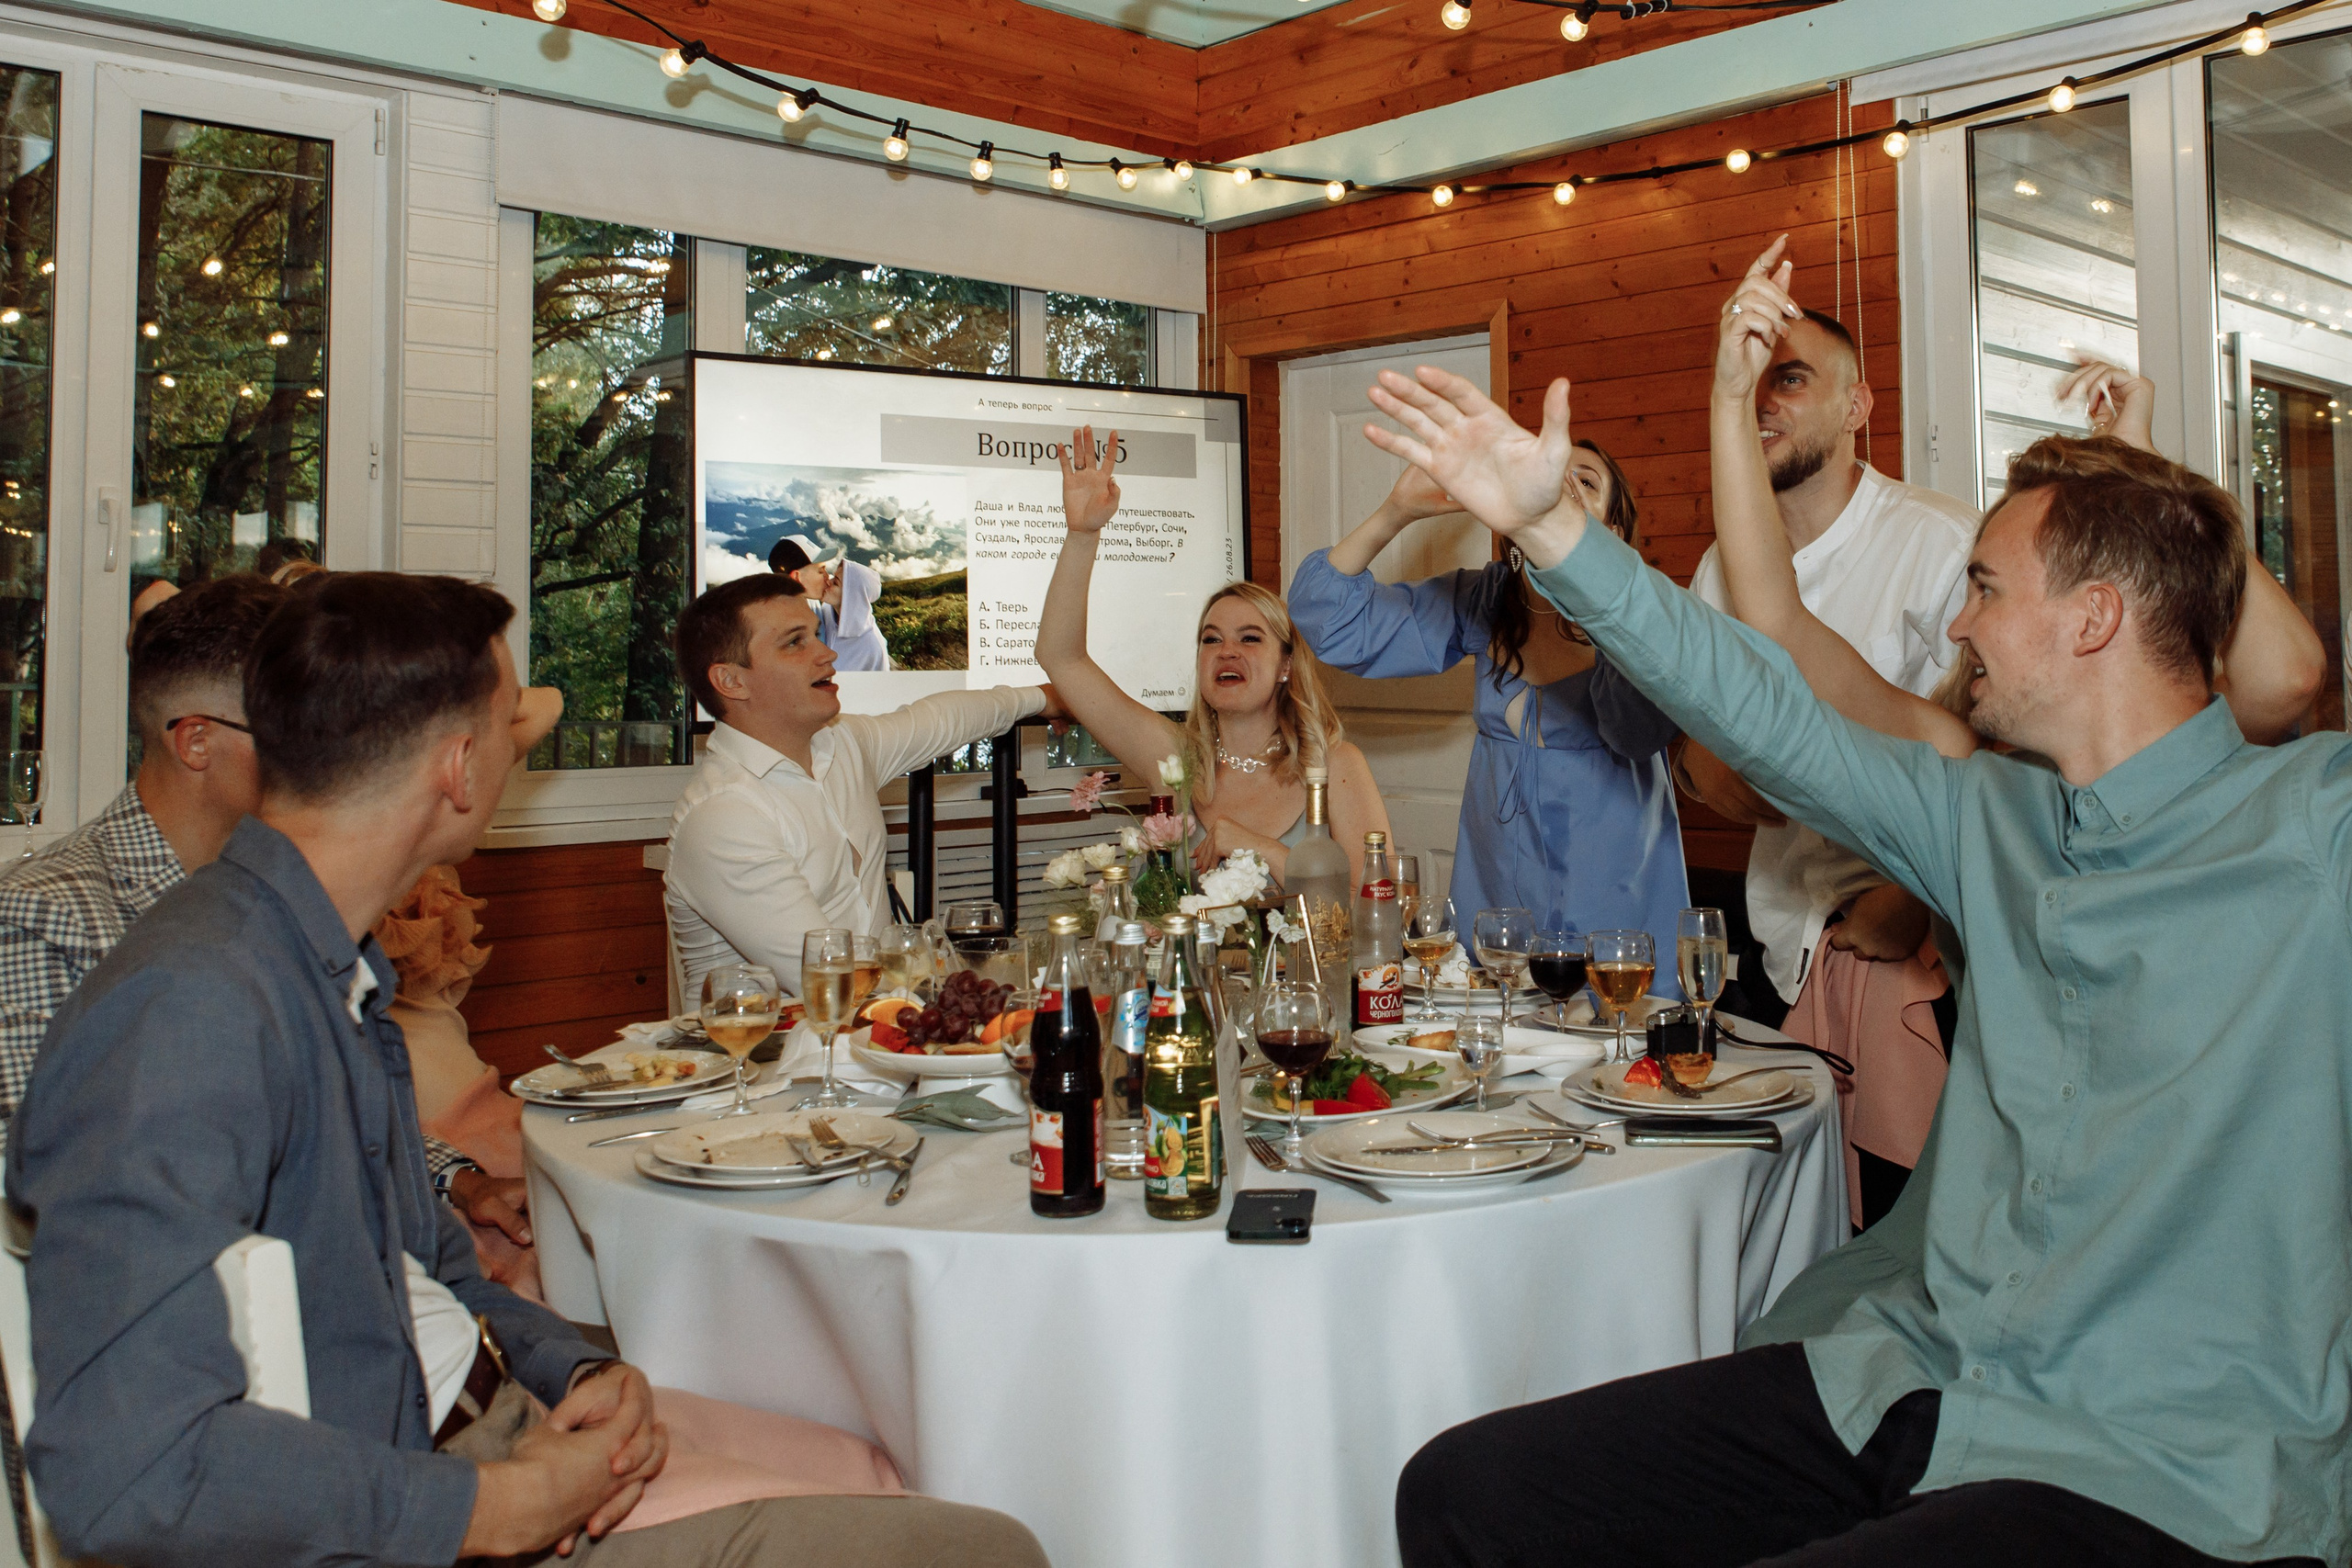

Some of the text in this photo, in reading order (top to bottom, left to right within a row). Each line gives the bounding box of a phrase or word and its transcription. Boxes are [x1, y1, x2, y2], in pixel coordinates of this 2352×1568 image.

[978, 398, 1053, 412] А теперь вопрос
[978, 433, 1072, 465] Вопрос
[975, 501, 1003, 512] Даша
[1018, 502, 1044, 513] Влад
[1046, 504, 1066, 513] люб
[1118, 508, 1195, 519] путешествовать.
[975, 516, 997, 526] Они
[1000, 519, 1020, 528] уже
[1102, 521, 1159, 534] -Петербург,
[1161, 523, 1187, 534] Сочи,
[975, 532, 1183, 549] Суздаль, Ярослав трома, Выборг. В
[975, 550, 1008, 558] каком
[1012, 549, 1046, 560] городе
[1104, 552, 1175, 563] молодожены?
[1225, 537, 1234, 576] 26.08.23
[978, 601, 1028, 614] А. Тверь
[979, 618, 1041, 632] Б. Пересла
[979, 637, 1035, 649] В. Сарато
[979, 655, 1040, 666] Г. Нижнев
[1141, 688, 1175, 698] Думаем
